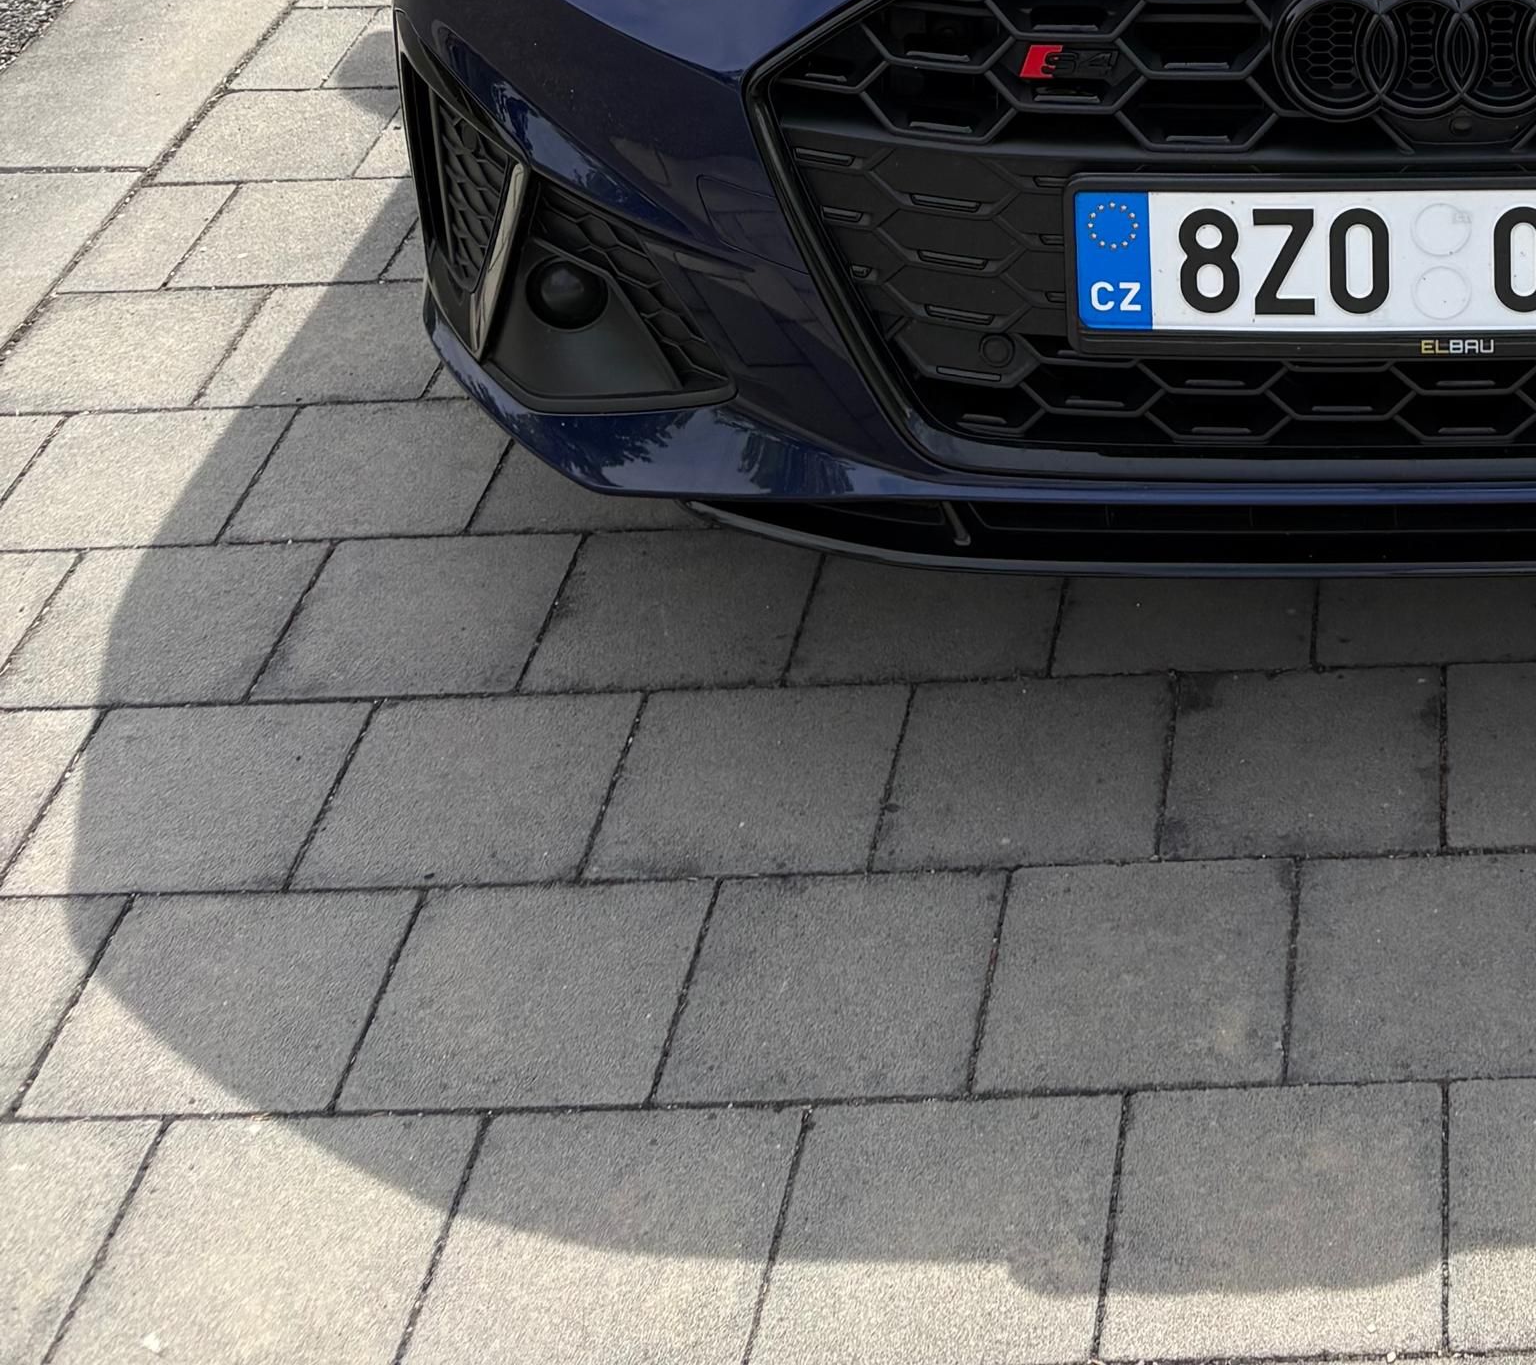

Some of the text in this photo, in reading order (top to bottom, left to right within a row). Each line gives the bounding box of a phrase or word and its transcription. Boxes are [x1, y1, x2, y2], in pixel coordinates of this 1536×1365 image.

[1178, 207, 1390, 316] 8Z0
[1090, 281, 1142, 312] CZ
[1421, 338, 1495, 354] ELBAU
